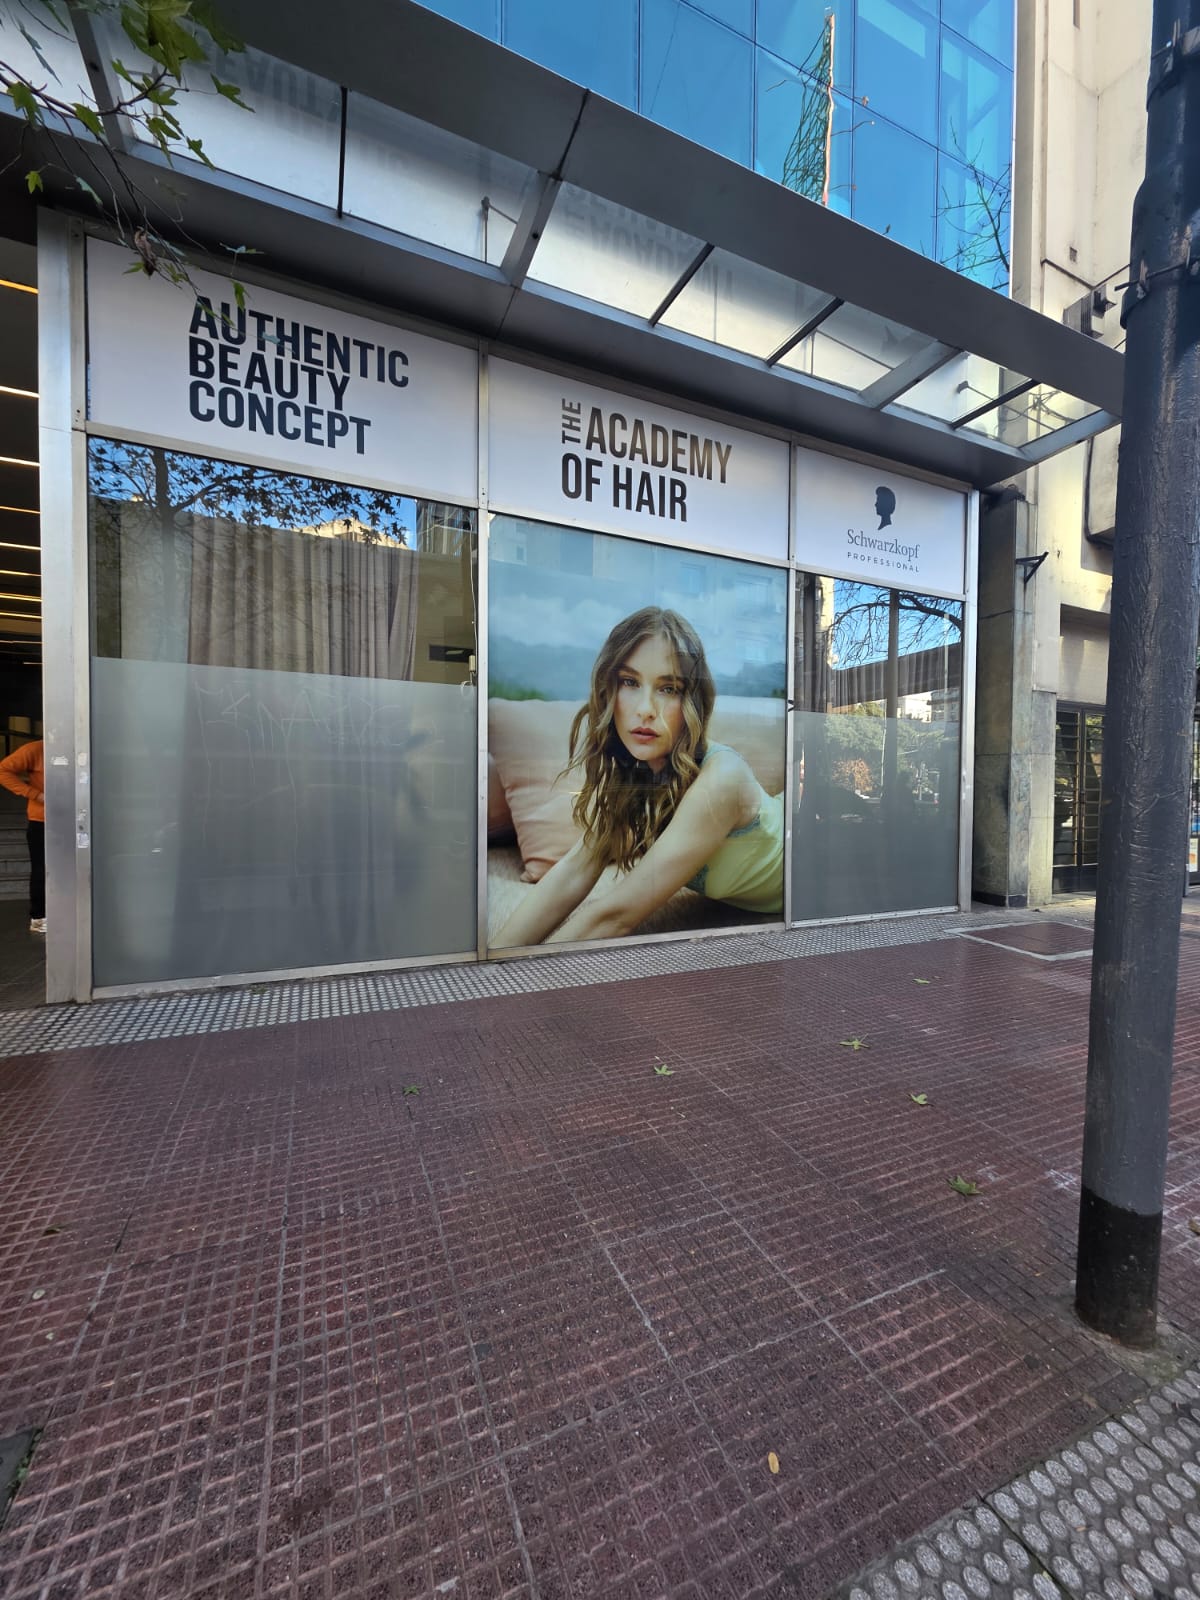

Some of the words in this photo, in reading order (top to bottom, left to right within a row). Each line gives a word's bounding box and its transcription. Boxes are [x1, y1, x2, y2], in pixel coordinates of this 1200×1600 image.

[189, 295, 409, 388] AUTHENTIC
[189, 335, 350, 411] BEAUTY
[189, 380, 371, 455] CONCEPT
[562, 398, 581, 444] THE
[585, 406, 733, 484] ACADEMY
[562, 452, 603, 503] OF
[613, 464, 688, 522] HAIR
[847, 528, 921, 562] Schwarzkopf
[847, 551, 920, 573] PROFESSIONAL
